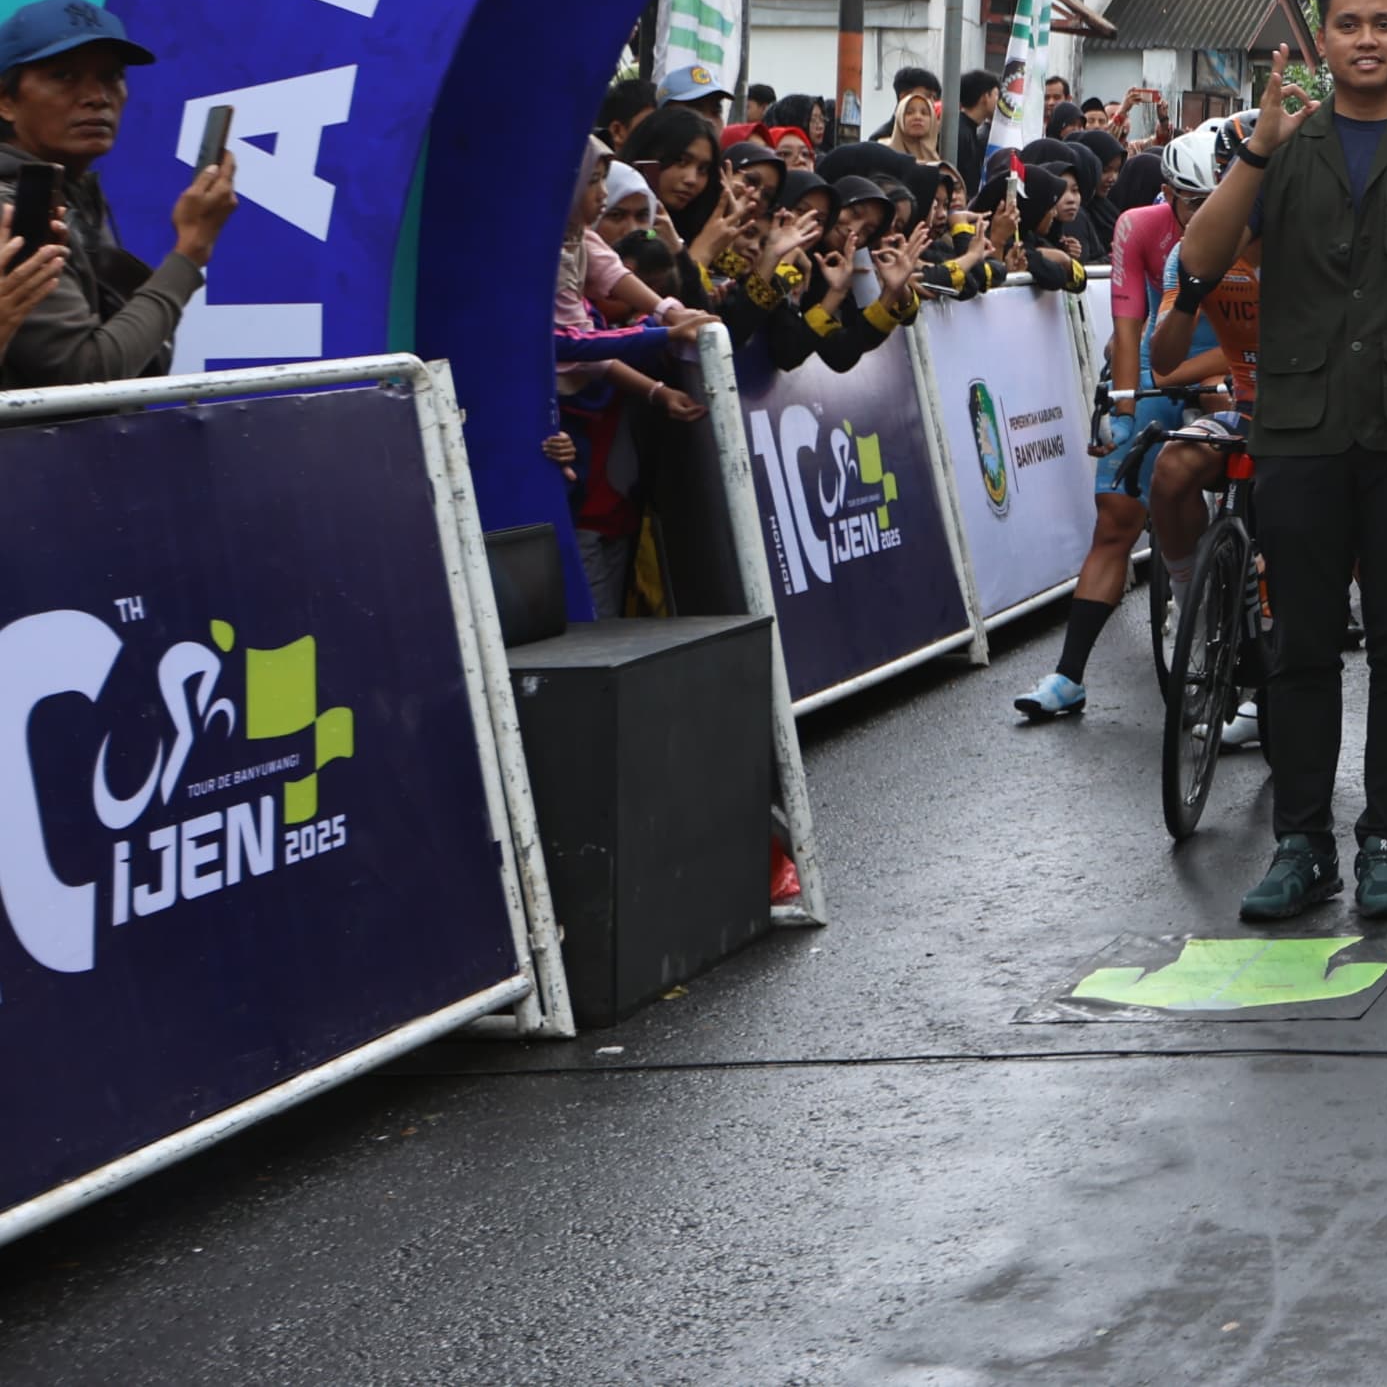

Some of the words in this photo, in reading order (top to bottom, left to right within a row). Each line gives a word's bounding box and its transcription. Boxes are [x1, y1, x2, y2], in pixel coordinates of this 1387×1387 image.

[1015, 433, 1066, 469] BANYUWANGI
[769, 515, 793, 596] EDITION
[880, 526, 901, 550] 2025
[114, 595, 145, 623] TH
[187, 780, 217, 799] TOUR
[217, 775, 232, 790] DE
[233, 752, 300, 785] BANYUWANGI
[285, 814, 346, 865] 2025
